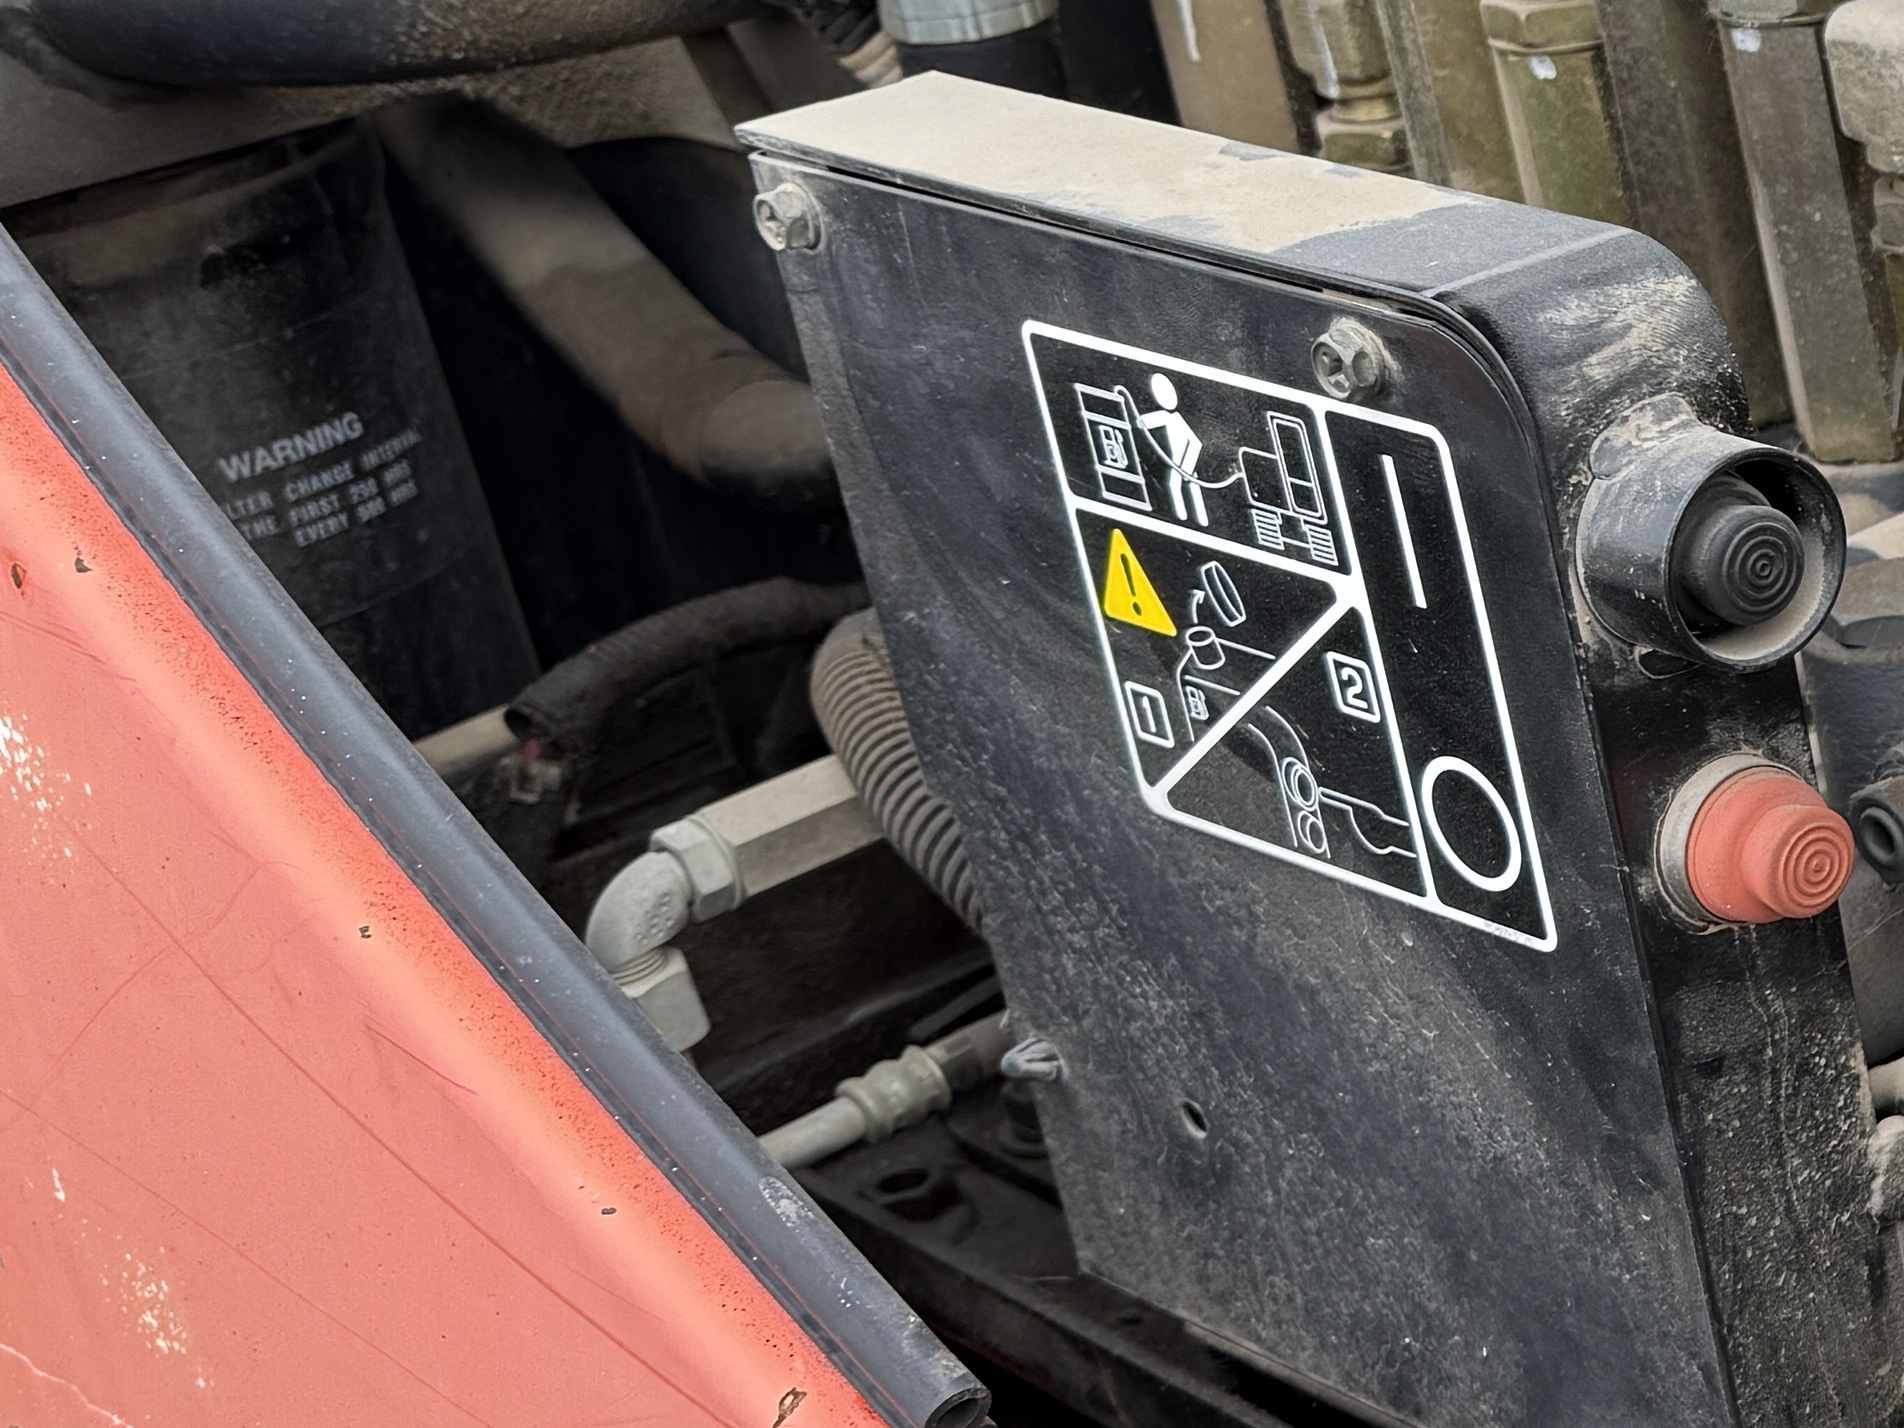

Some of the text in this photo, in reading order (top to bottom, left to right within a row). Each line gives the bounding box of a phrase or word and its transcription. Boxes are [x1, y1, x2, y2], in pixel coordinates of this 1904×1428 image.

[216, 410, 365, 483] WARNING
[1340, 666, 1369, 710] 2
[1142, 695, 1157, 734] 1
